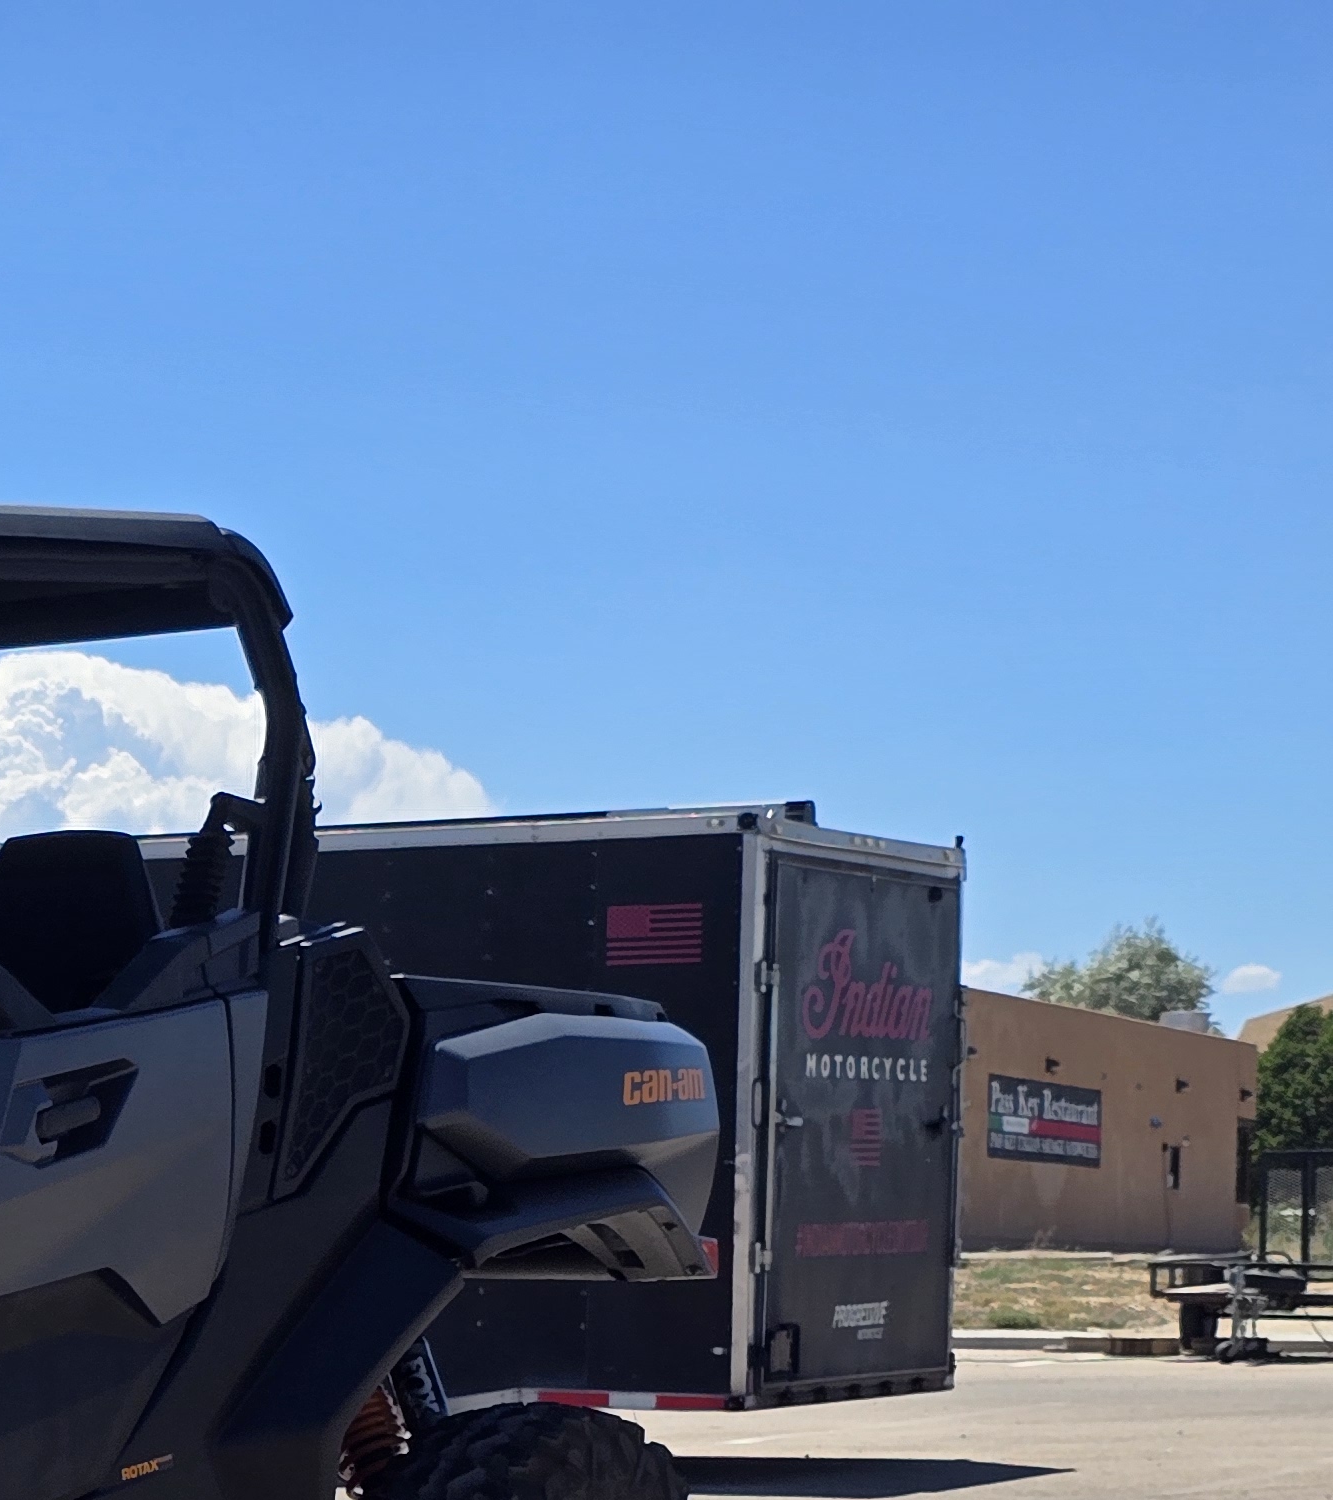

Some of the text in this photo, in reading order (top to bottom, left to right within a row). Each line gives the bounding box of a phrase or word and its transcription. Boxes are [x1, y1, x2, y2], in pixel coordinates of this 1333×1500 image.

[801, 928, 933, 1041] Indian
[804, 1052, 929, 1083] MOTORCYCLE
[622, 1068, 706, 1106] can-am
[121, 1459, 160, 1481] ROTAX
